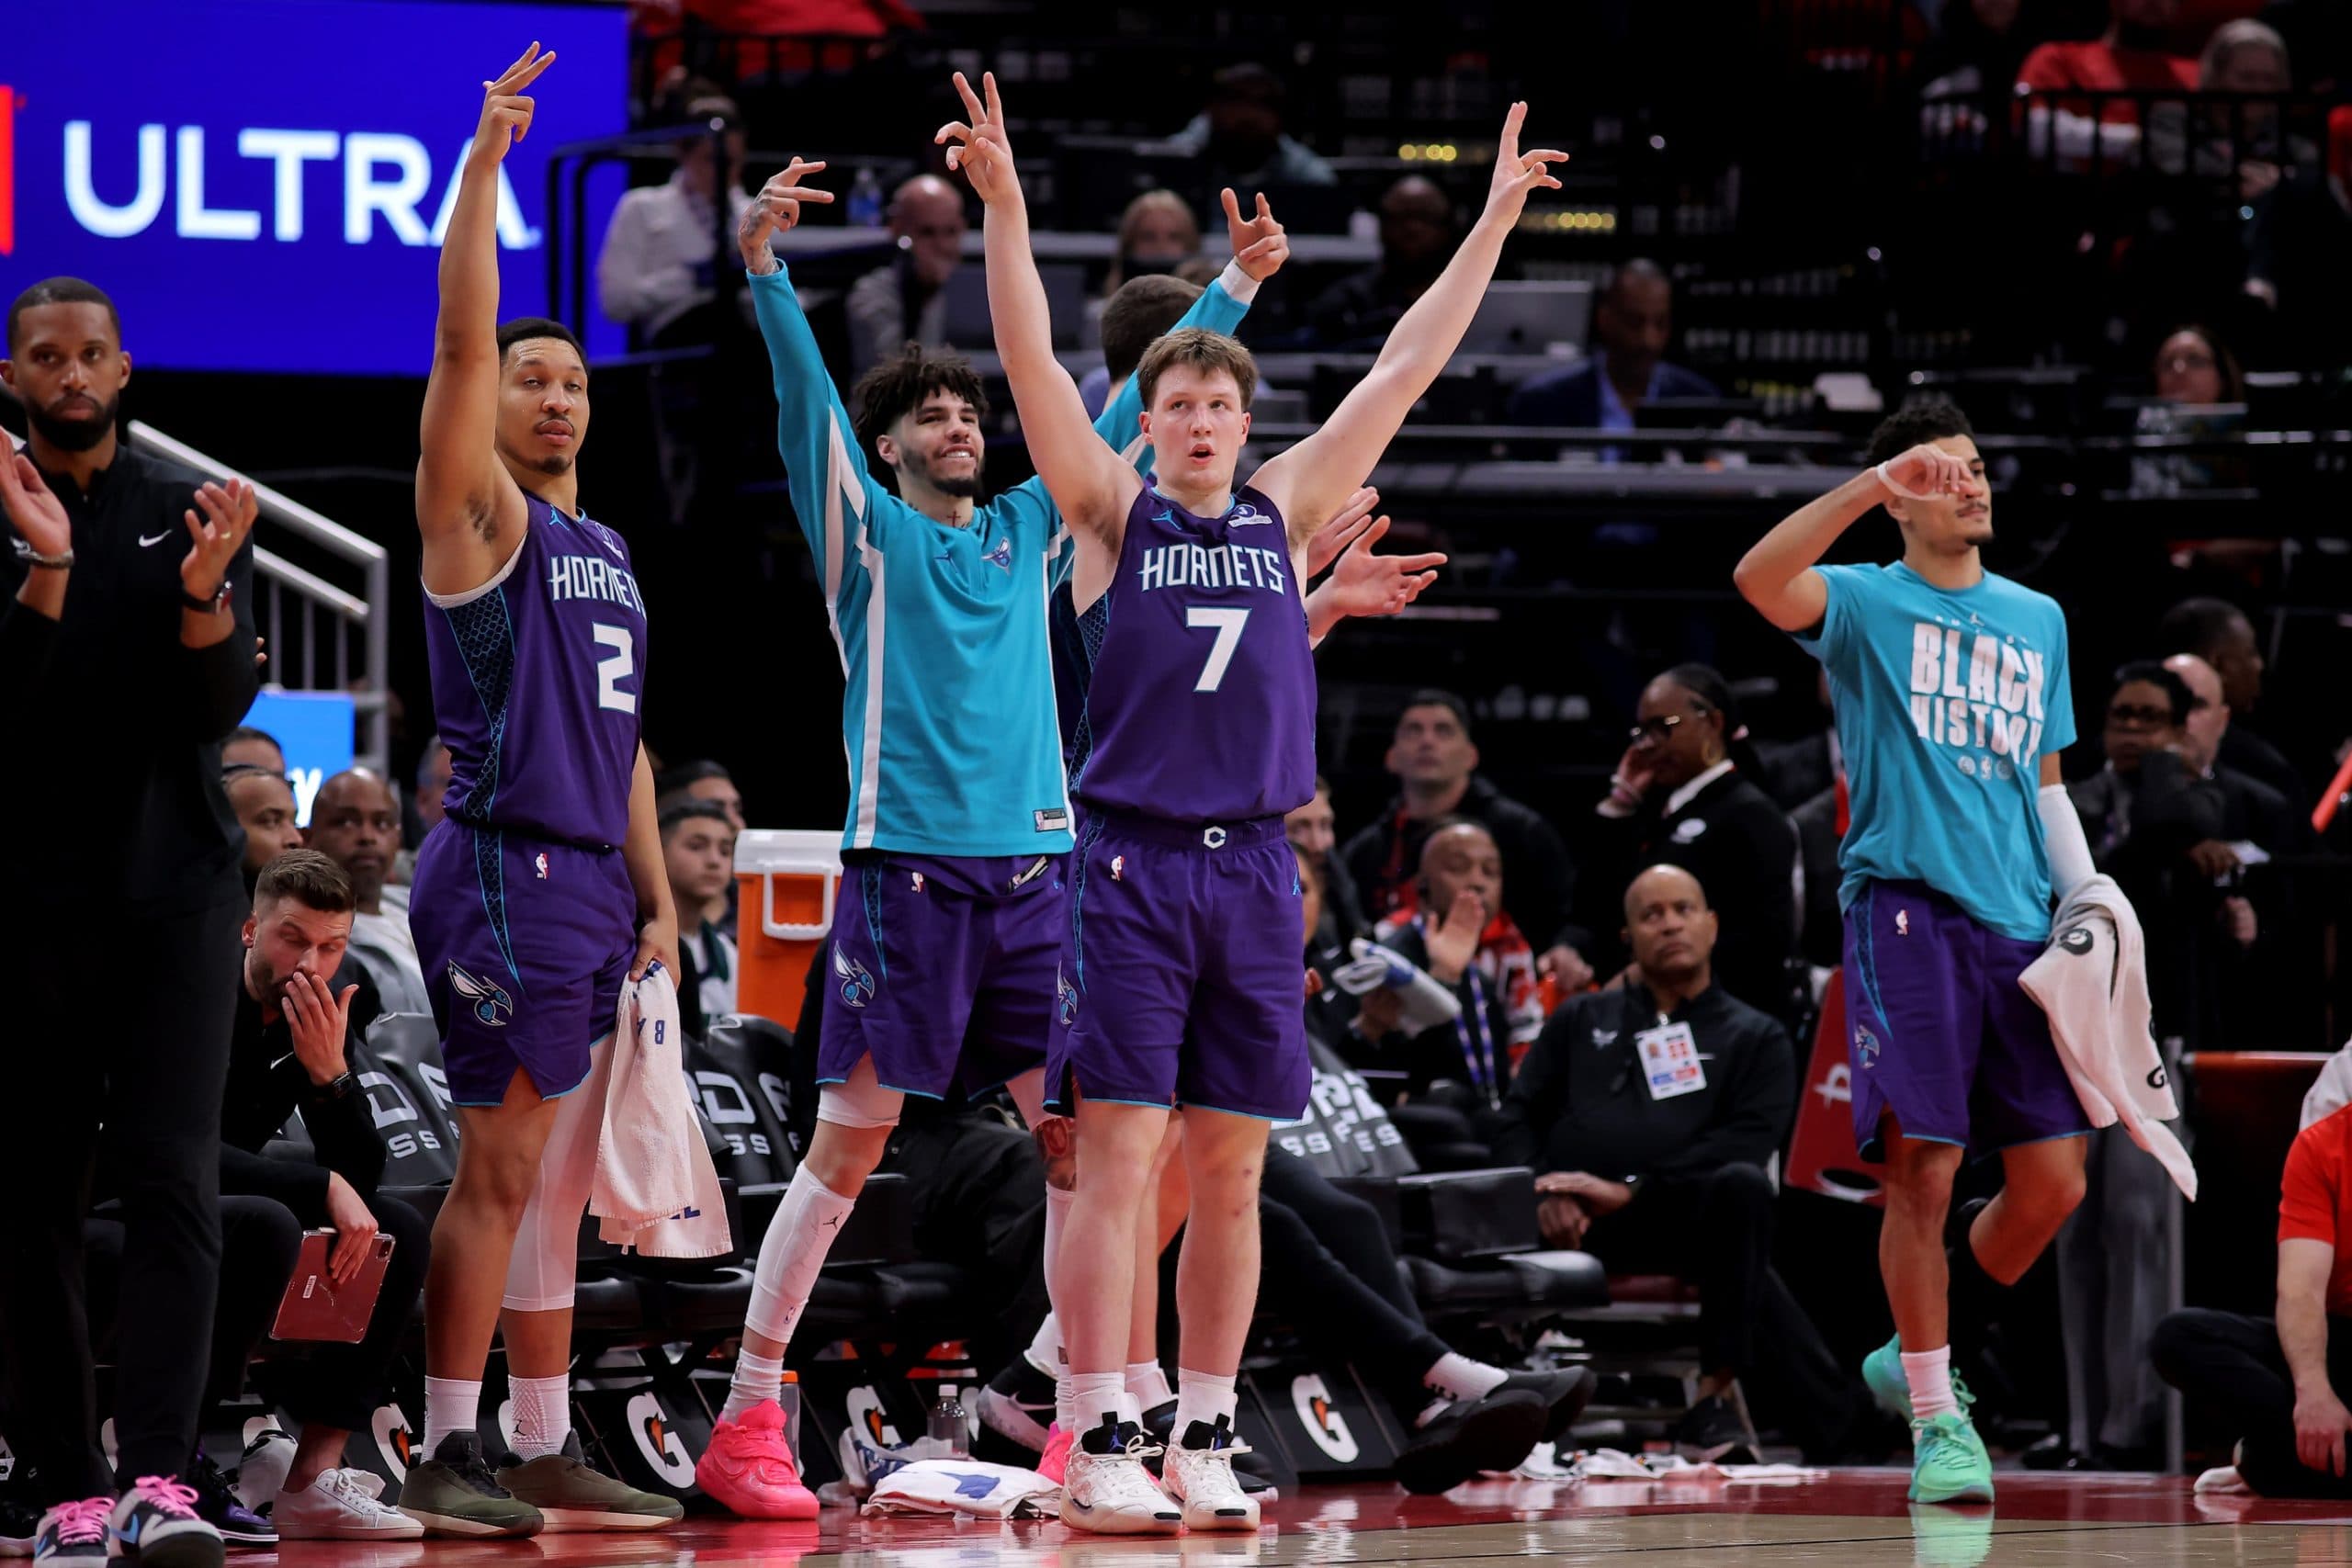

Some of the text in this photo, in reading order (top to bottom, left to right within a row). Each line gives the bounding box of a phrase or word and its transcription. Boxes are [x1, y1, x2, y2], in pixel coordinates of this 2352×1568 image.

[63, 119, 535, 250] ULTRA
[548, 555, 647, 621] HORNET
[1137, 542, 1286, 595] HORNETS
[593, 621, 636, 715] 2
[1185, 606, 1252, 692] 7
[1911, 622, 2044, 722] BLACK
[1910, 695, 2042, 768] HISTORY
[627, 1392, 696, 1489] G
[1291, 1374, 1359, 1463] G
